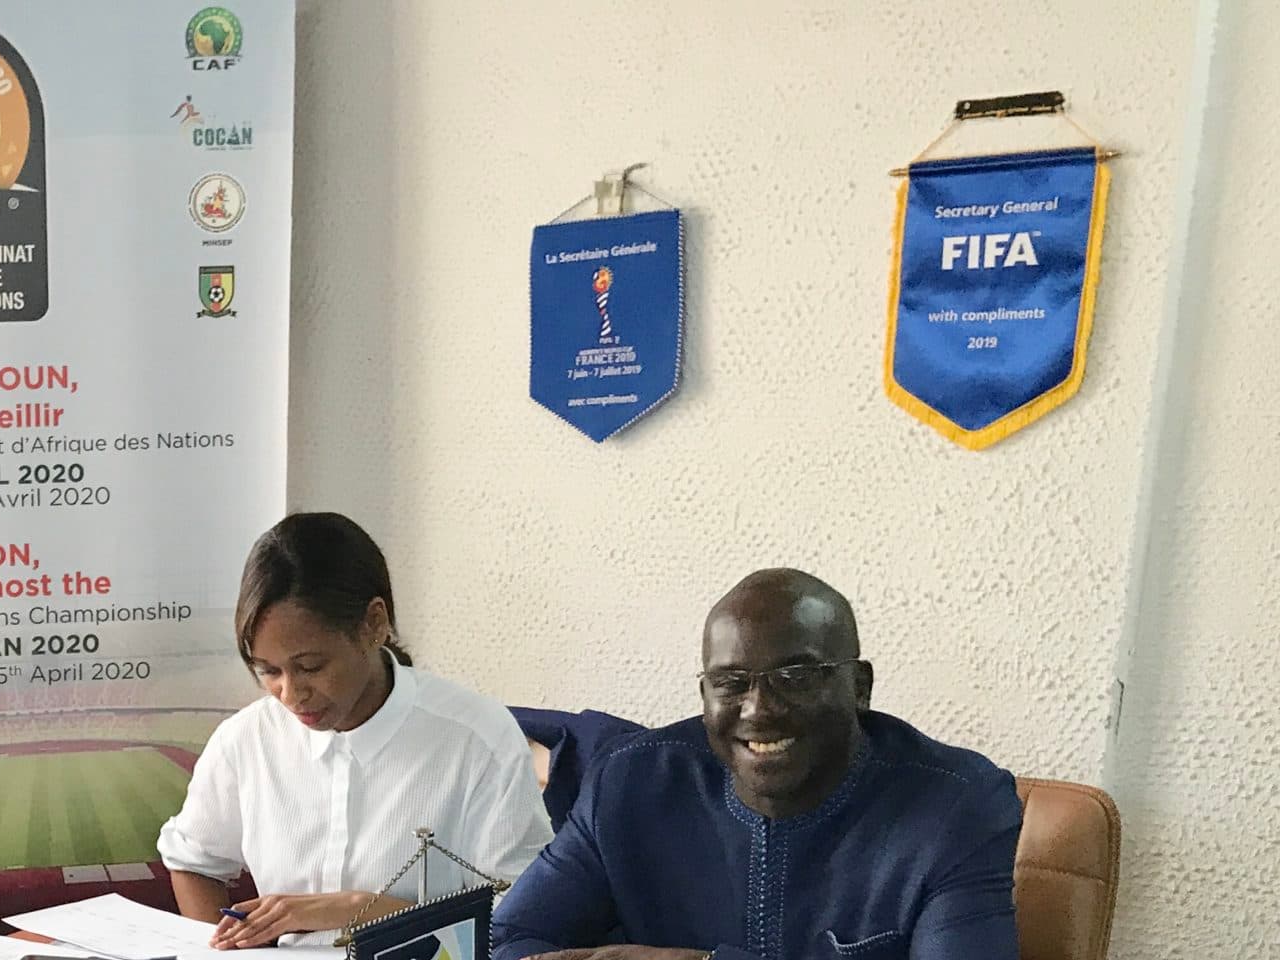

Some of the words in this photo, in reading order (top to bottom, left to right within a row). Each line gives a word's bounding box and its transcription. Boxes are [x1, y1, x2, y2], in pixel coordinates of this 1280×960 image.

[192, 59, 236, 71] CAF
[934, 202, 1000, 219] Secretary
[1002, 197, 1058, 213] General
[545, 253, 558, 265] La
[559, 249, 609, 263] Secrétaire
[941, 232, 1039, 270] FIFA
[928, 309, 958, 323] with
[962, 307, 1046, 324] compliments
[967, 336, 998, 350] 2019
[575, 352, 614, 366] FRANCE
[114, 433, 150, 450] des
[157, 431, 234, 449] Nations
[18, 464, 85, 484] 2020
[50, 487, 110, 507] 2020
[63, 572, 111, 594] the
[29, 602, 192, 627] Championship
[32, 634, 99, 655] 2020
[30, 663, 83, 684] April
[91, 661, 151, 681] 2020
